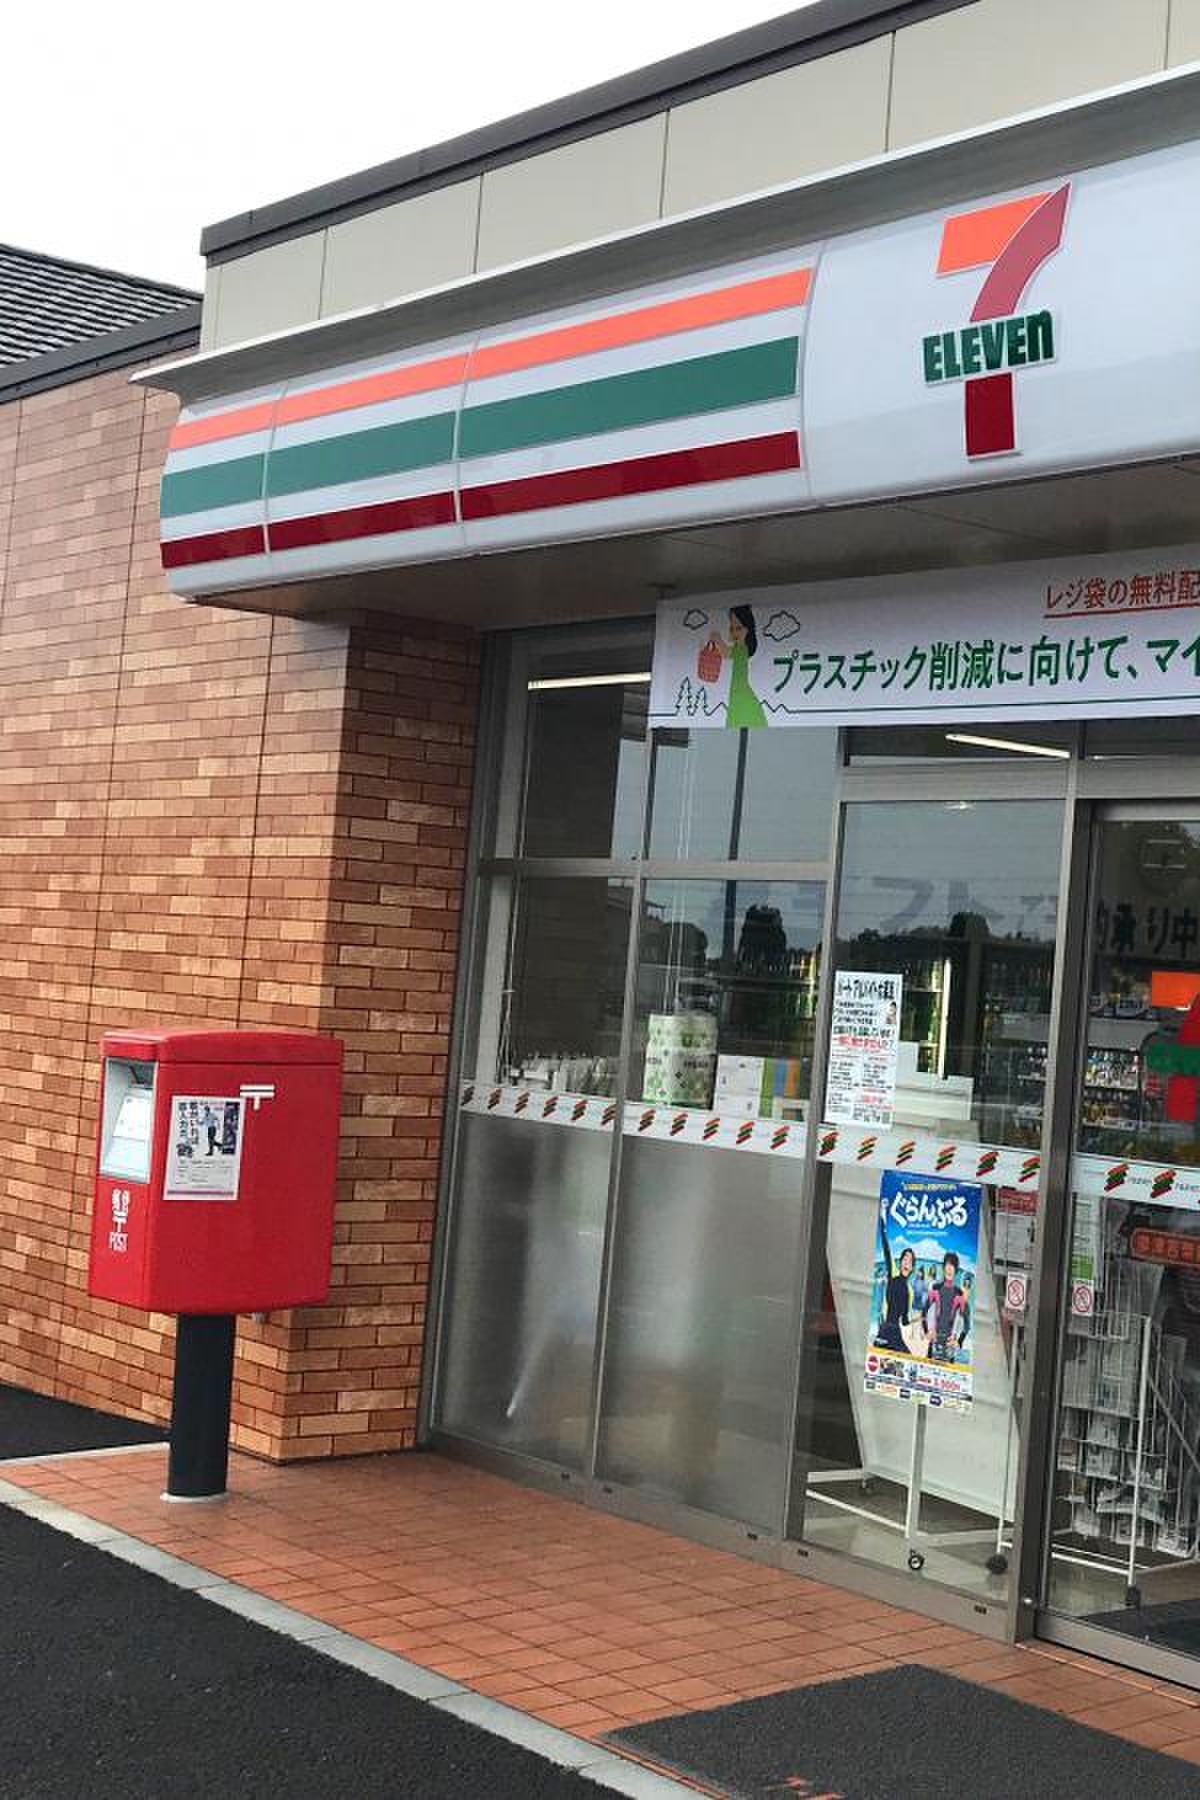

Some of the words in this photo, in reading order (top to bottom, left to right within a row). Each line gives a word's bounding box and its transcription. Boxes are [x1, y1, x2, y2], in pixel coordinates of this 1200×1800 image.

[922, 308, 1056, 384] ELEVEN
[890, 1190, 968, 1229] ぐらんぶる
